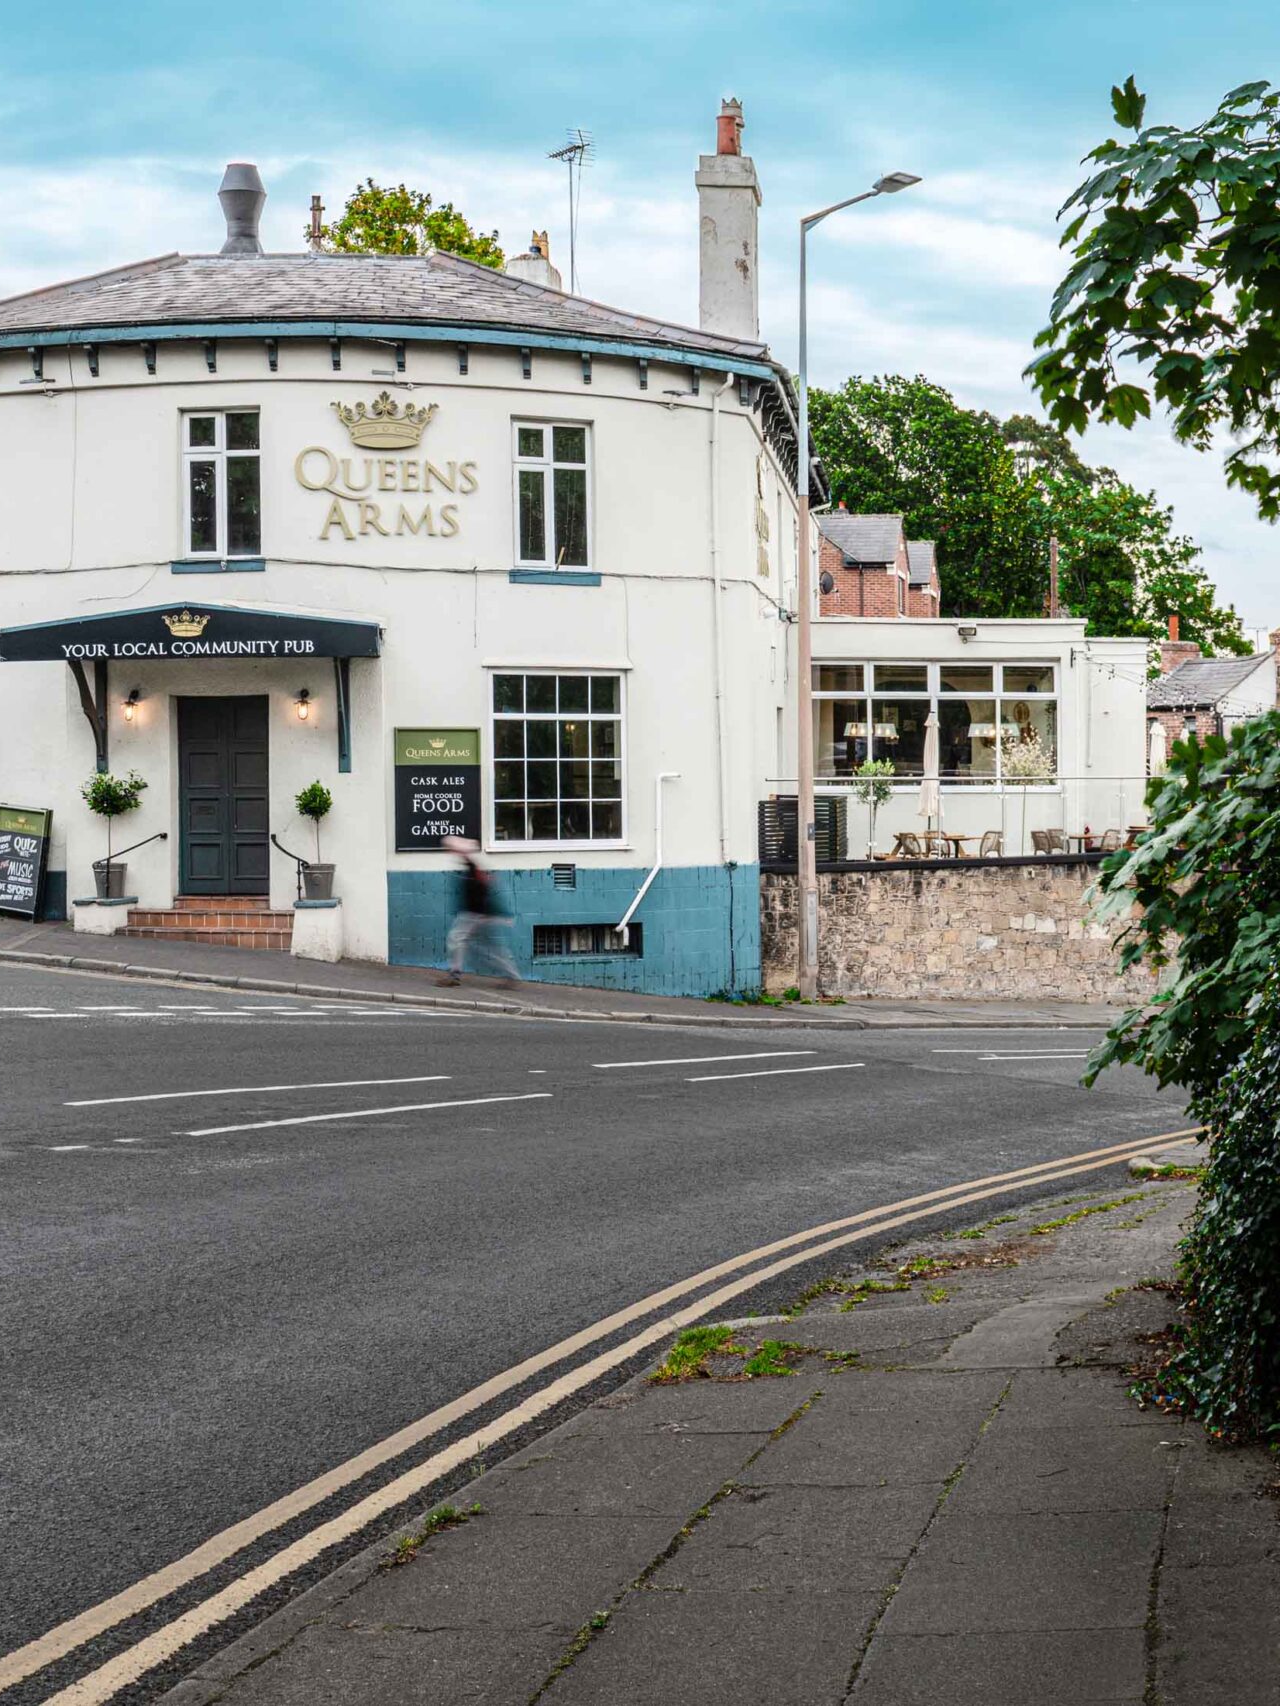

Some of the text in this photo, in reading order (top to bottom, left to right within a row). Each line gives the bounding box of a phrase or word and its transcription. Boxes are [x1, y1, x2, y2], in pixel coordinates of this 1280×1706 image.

[294, 446, 479, 501] QUEENS
[318, 499, 460, 540] ARMS
[62, 640, 315, 657] YOUR LOCAL COMMUNITY PUB
[405, 748, 470, 759] QUEENS ARMS
[411, 777, 465, 785] CASK ALES
[412, 799, 464, 813] FOOD
[411, 825, 465, 835] GARDEN
[14, 836, 37, 854] QUIZ
[7, 861, 34, 878] MUSIC
[6, 884, 34, 897] SPORTS
